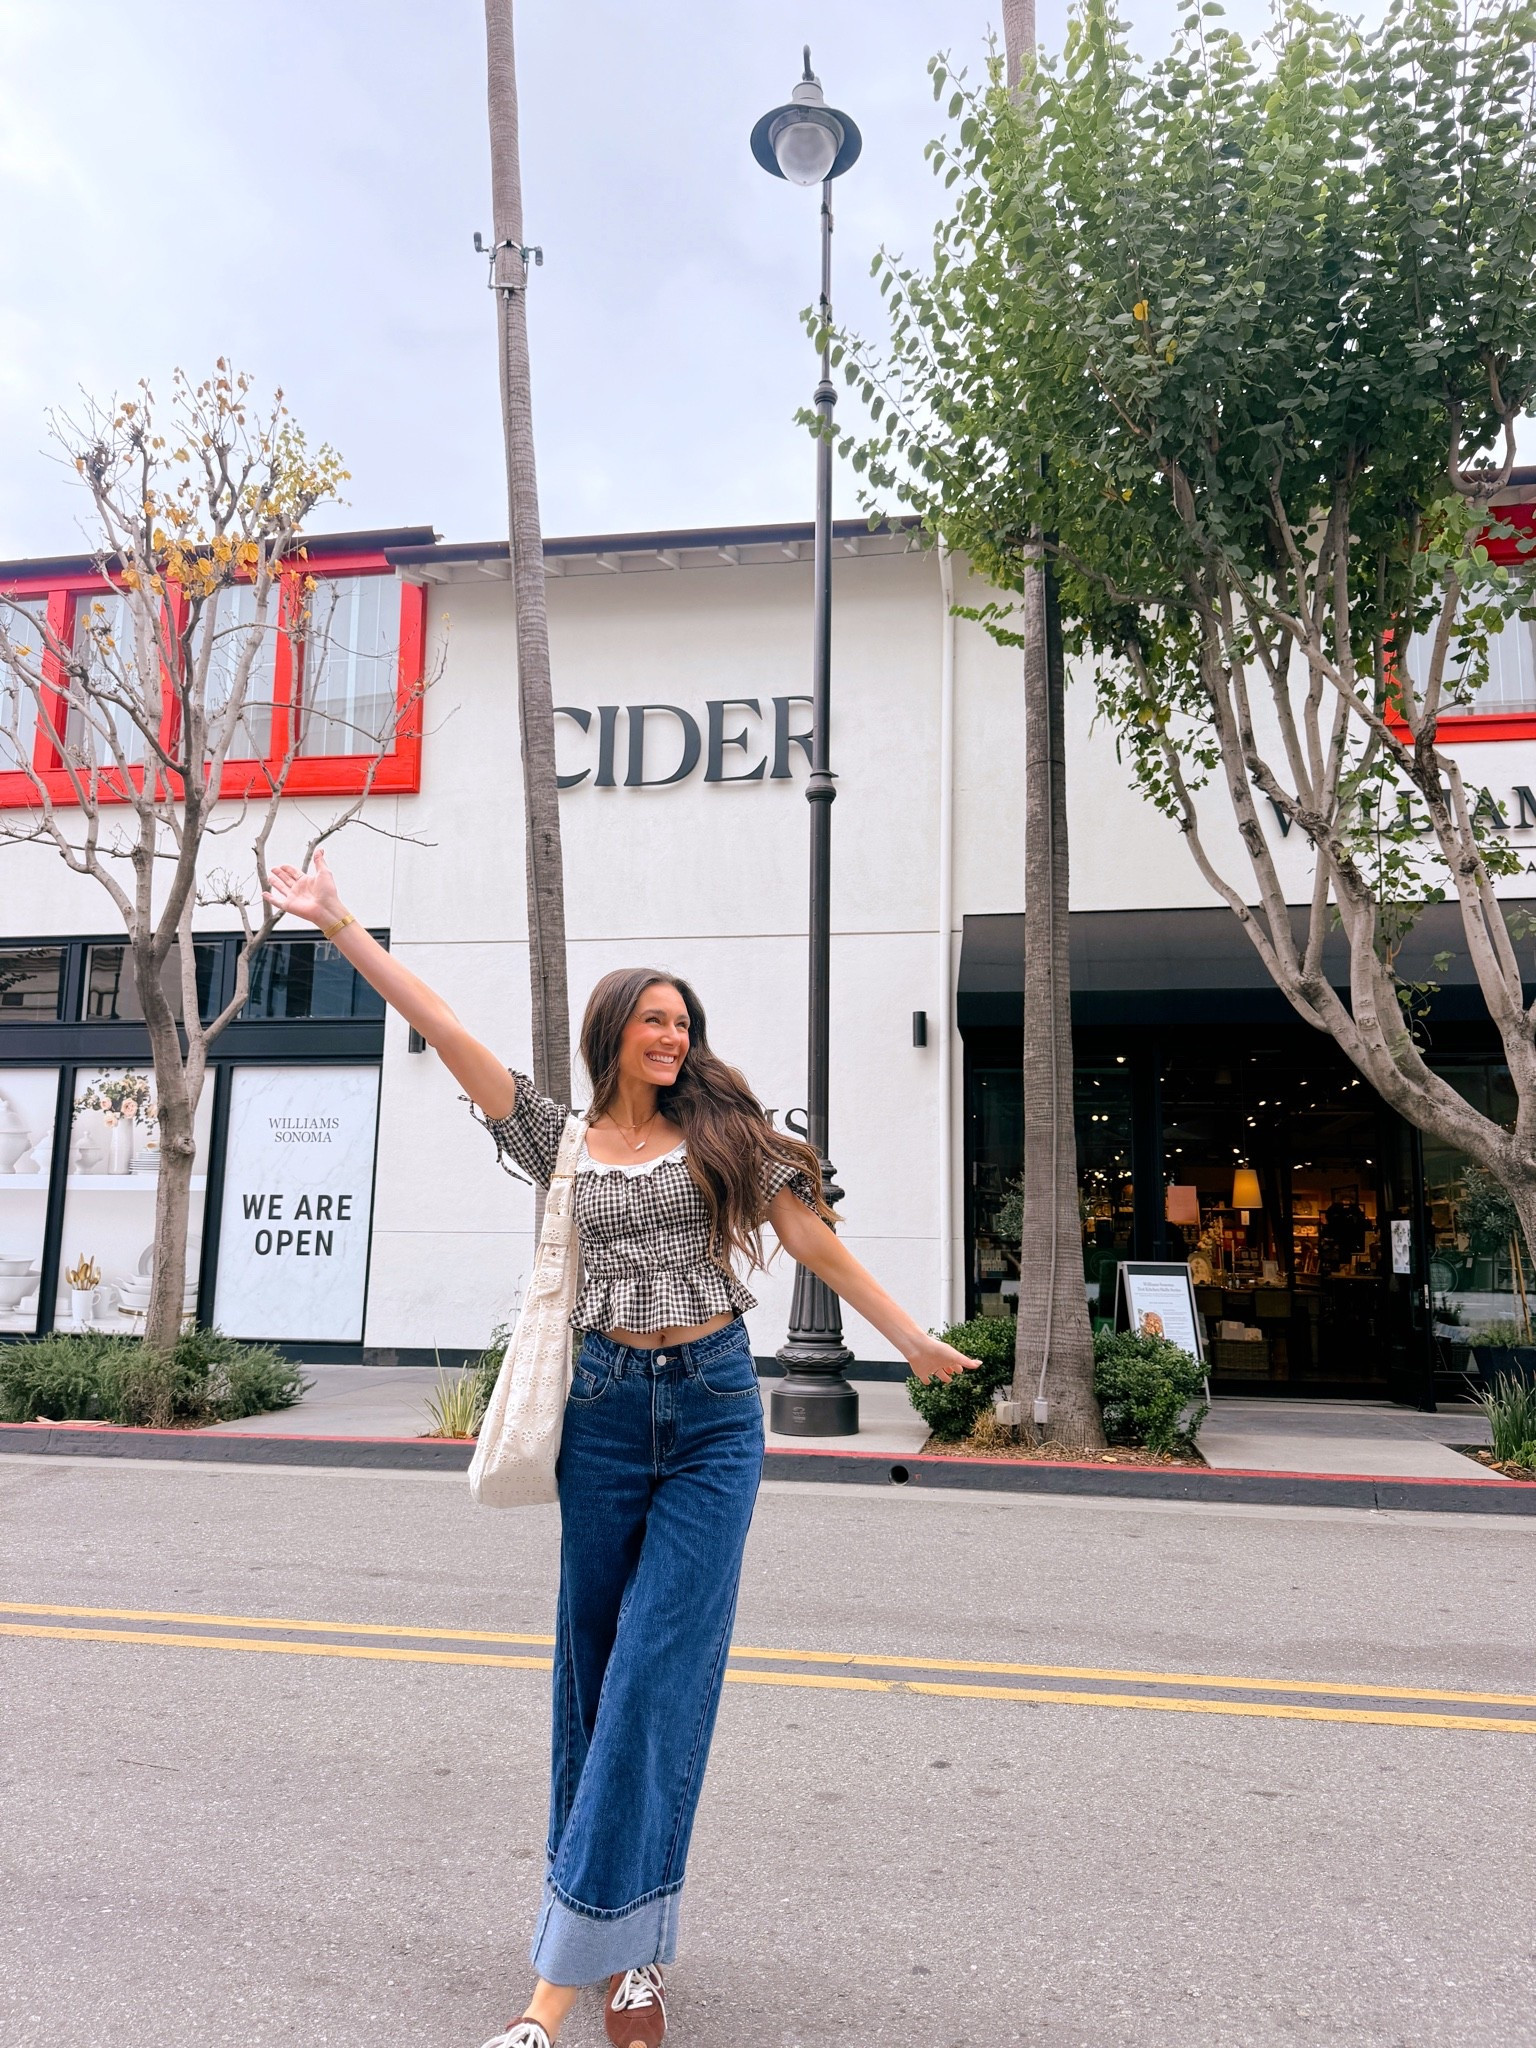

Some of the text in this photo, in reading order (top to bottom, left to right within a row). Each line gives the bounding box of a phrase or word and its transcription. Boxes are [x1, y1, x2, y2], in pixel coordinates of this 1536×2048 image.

[269, 1117, 340, 1130] WILLIAMS
[274, 1131, 332, 1143] SONOMA
[243, 1194, 353, 1221] WE ARE
[255, 1229, 334, 1256] OPEN
